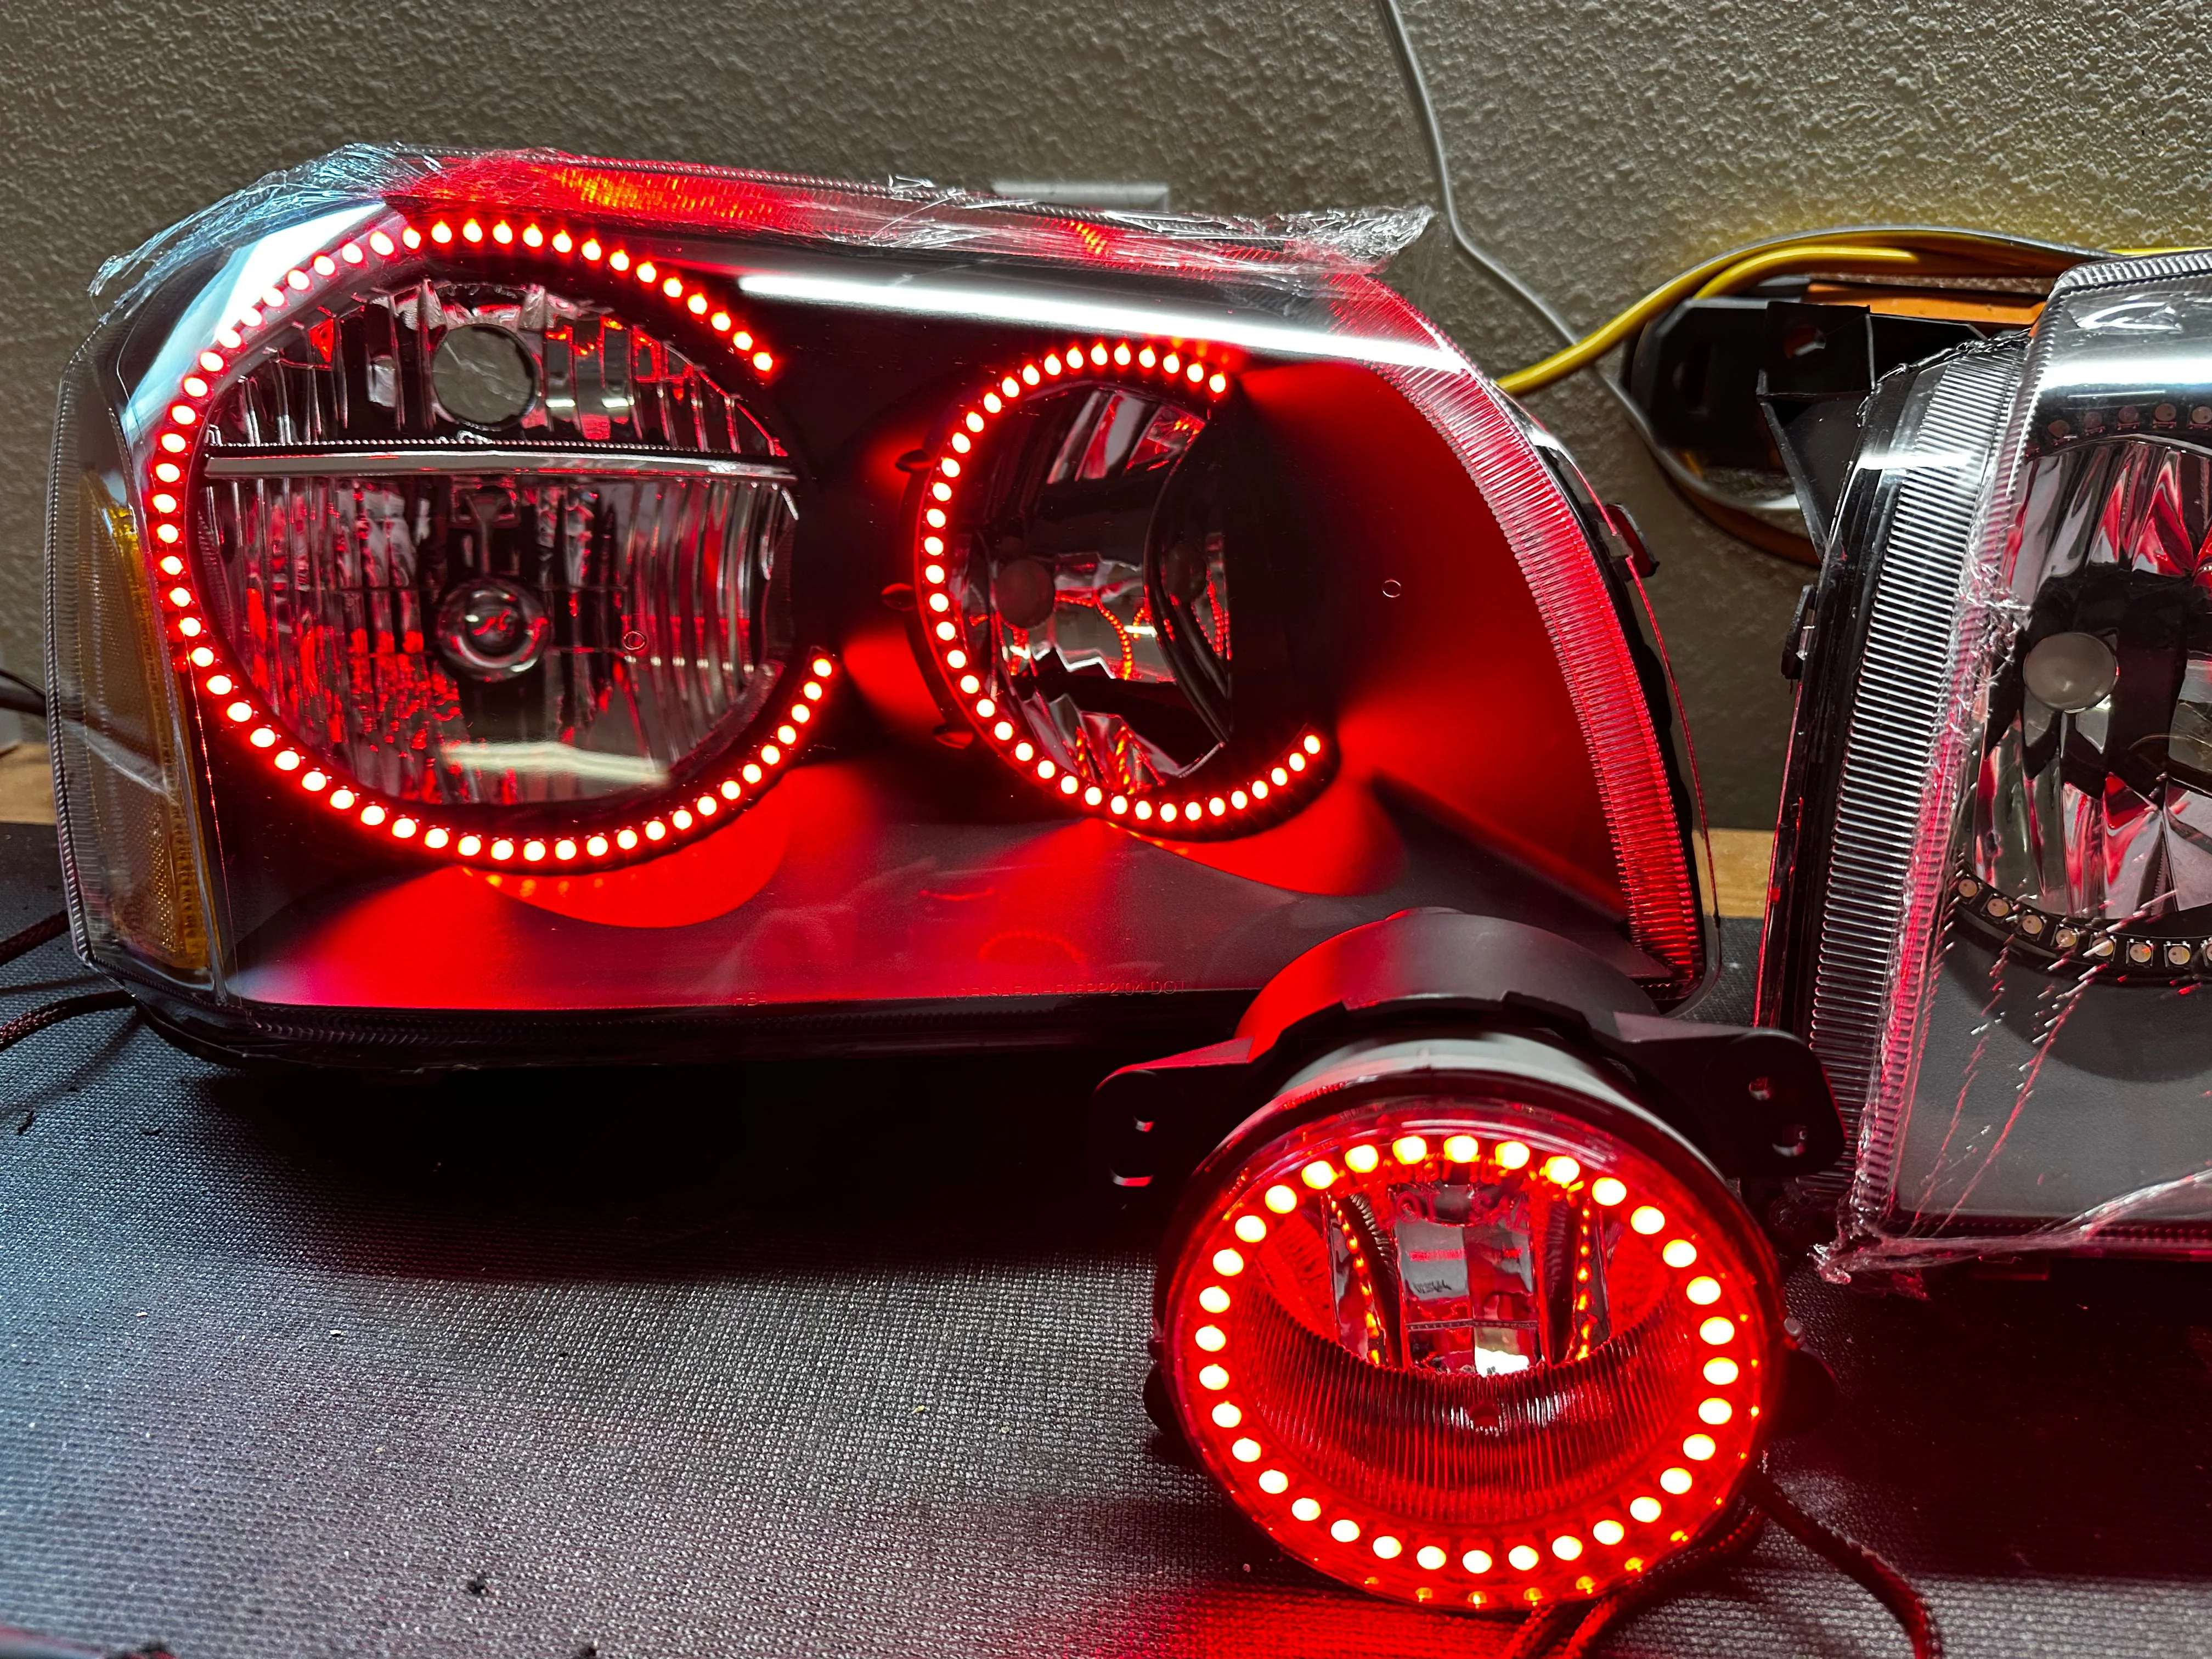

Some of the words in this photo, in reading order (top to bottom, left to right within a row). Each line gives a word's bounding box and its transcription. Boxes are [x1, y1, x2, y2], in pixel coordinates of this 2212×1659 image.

[988, 985, 1023, 1000] SAE
[1125, 982, 1144, 995] 04
[1151, 981, 1187, 994] DOT
